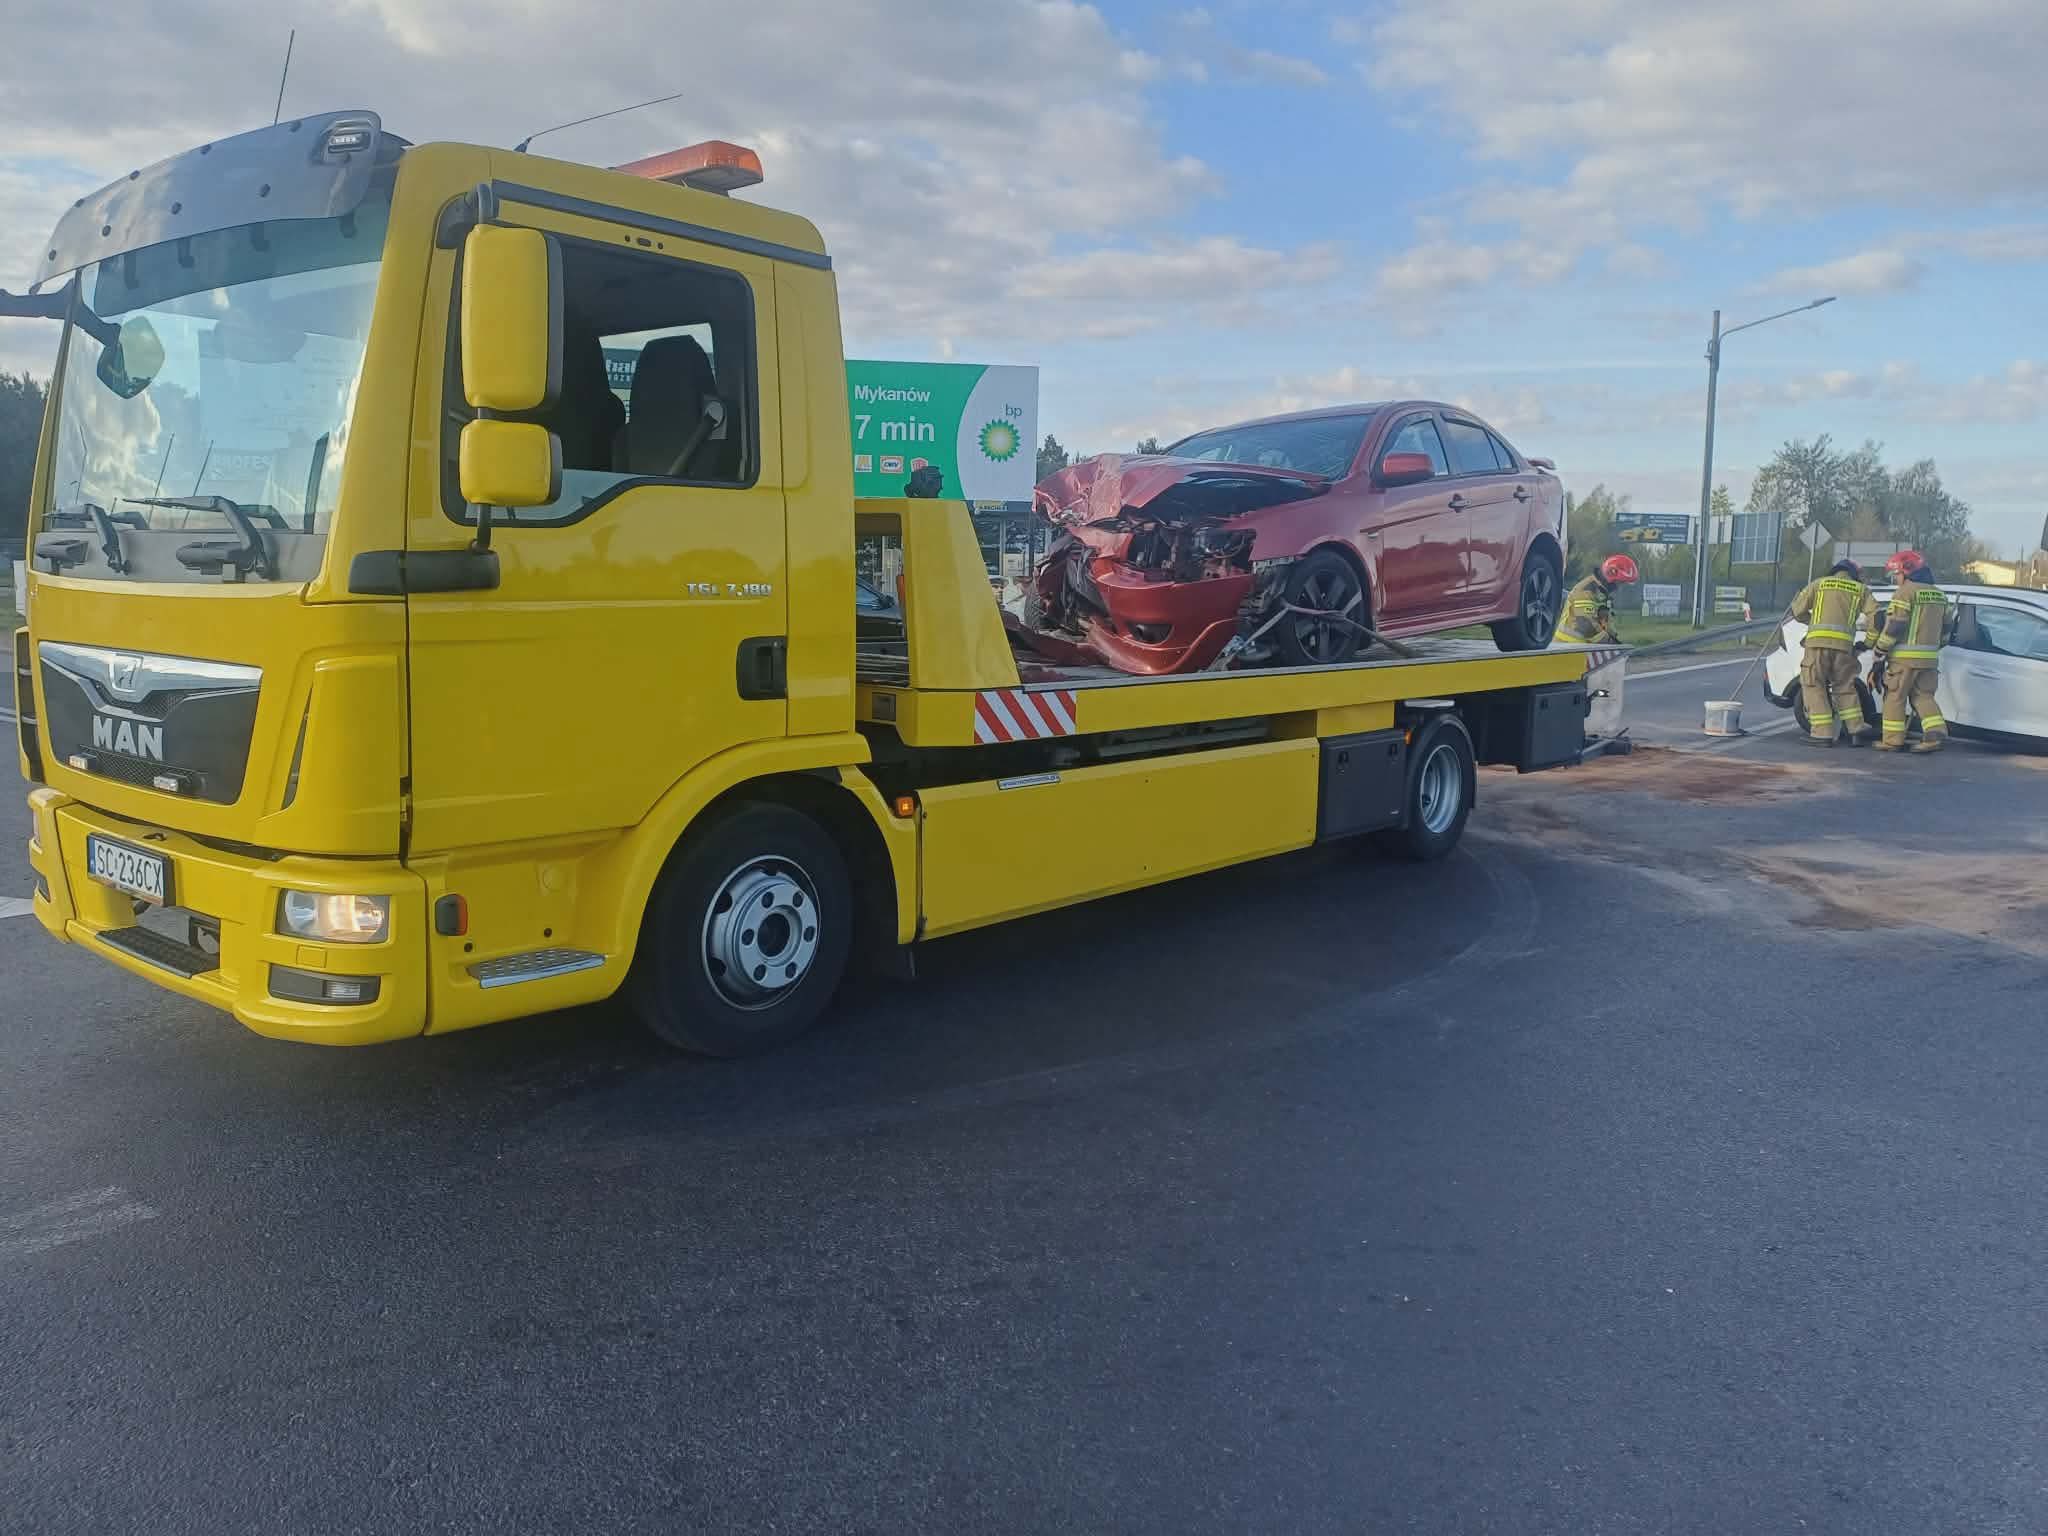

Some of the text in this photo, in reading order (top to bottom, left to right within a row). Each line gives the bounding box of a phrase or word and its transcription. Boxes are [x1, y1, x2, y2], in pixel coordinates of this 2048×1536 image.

[854, 384, 931, 404] Mykanów
[1005, 403, 1023, 418] bp
[854, 414, 936, 442] 7 min
[686, 583, 721, 595] TGL
[92, 714, 164, 762] MAN
[96, 844, 163, 897] SC 236CX
